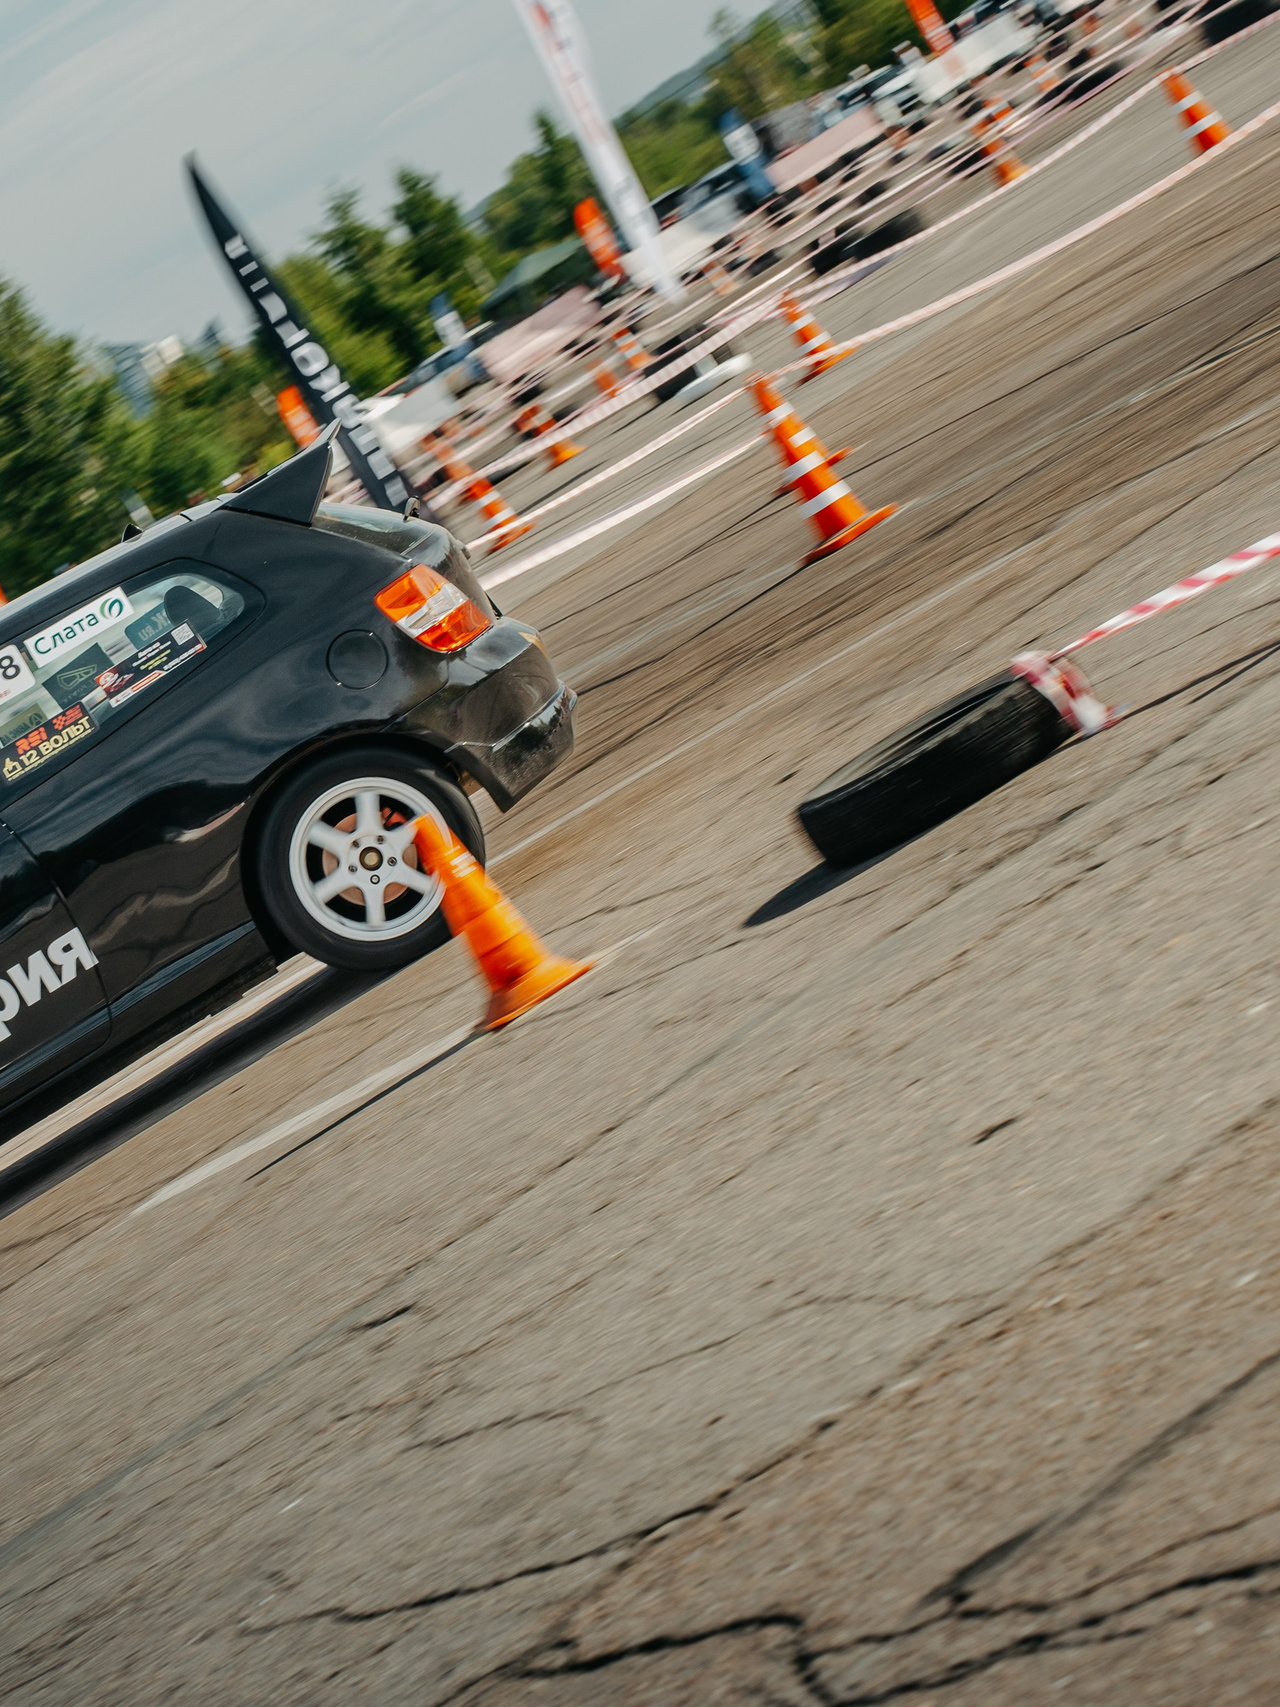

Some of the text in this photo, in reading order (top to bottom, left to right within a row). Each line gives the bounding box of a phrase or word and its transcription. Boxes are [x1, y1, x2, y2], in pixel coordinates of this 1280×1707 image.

[34, 613, 100, 655] Слата
[19, 749, 40, 766] 12
[38, 715, 91, 755] ВОЛЬТ
